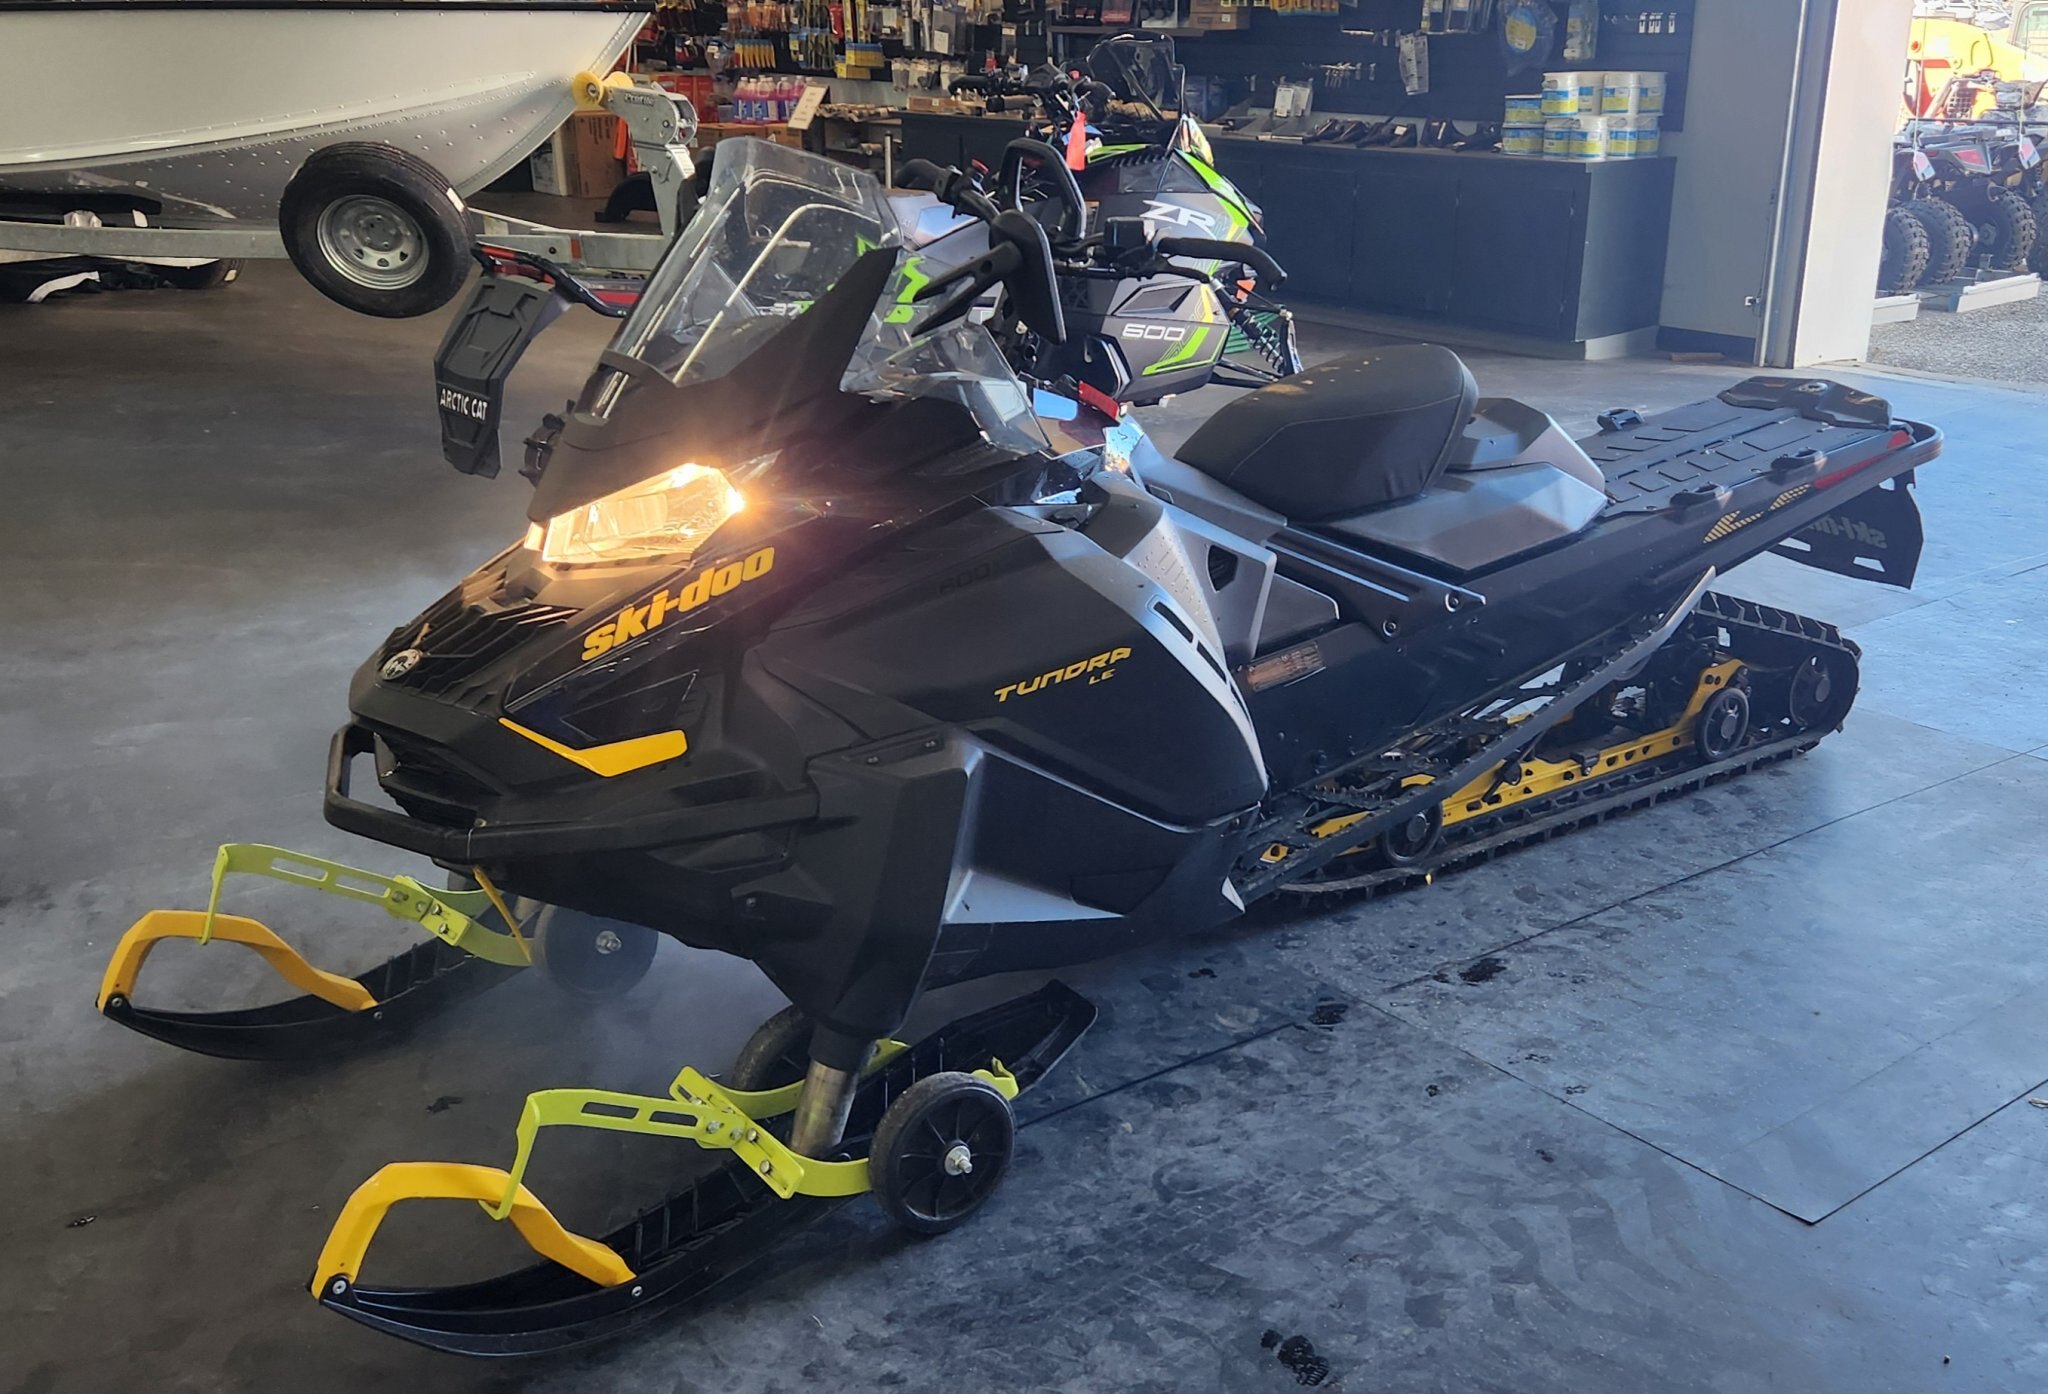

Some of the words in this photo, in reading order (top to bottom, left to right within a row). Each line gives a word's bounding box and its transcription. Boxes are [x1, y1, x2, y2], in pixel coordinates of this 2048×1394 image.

[1139, 200, 1217, 240] ZR
[1122, 323, 1186, 341] 600
[440, 388, 469, 415] ARCTIC
[471, 398, 488, 420] CAT
[994, 647, 1132, 702] TUNDRA
[1089, 668, 1115, 685] LE
